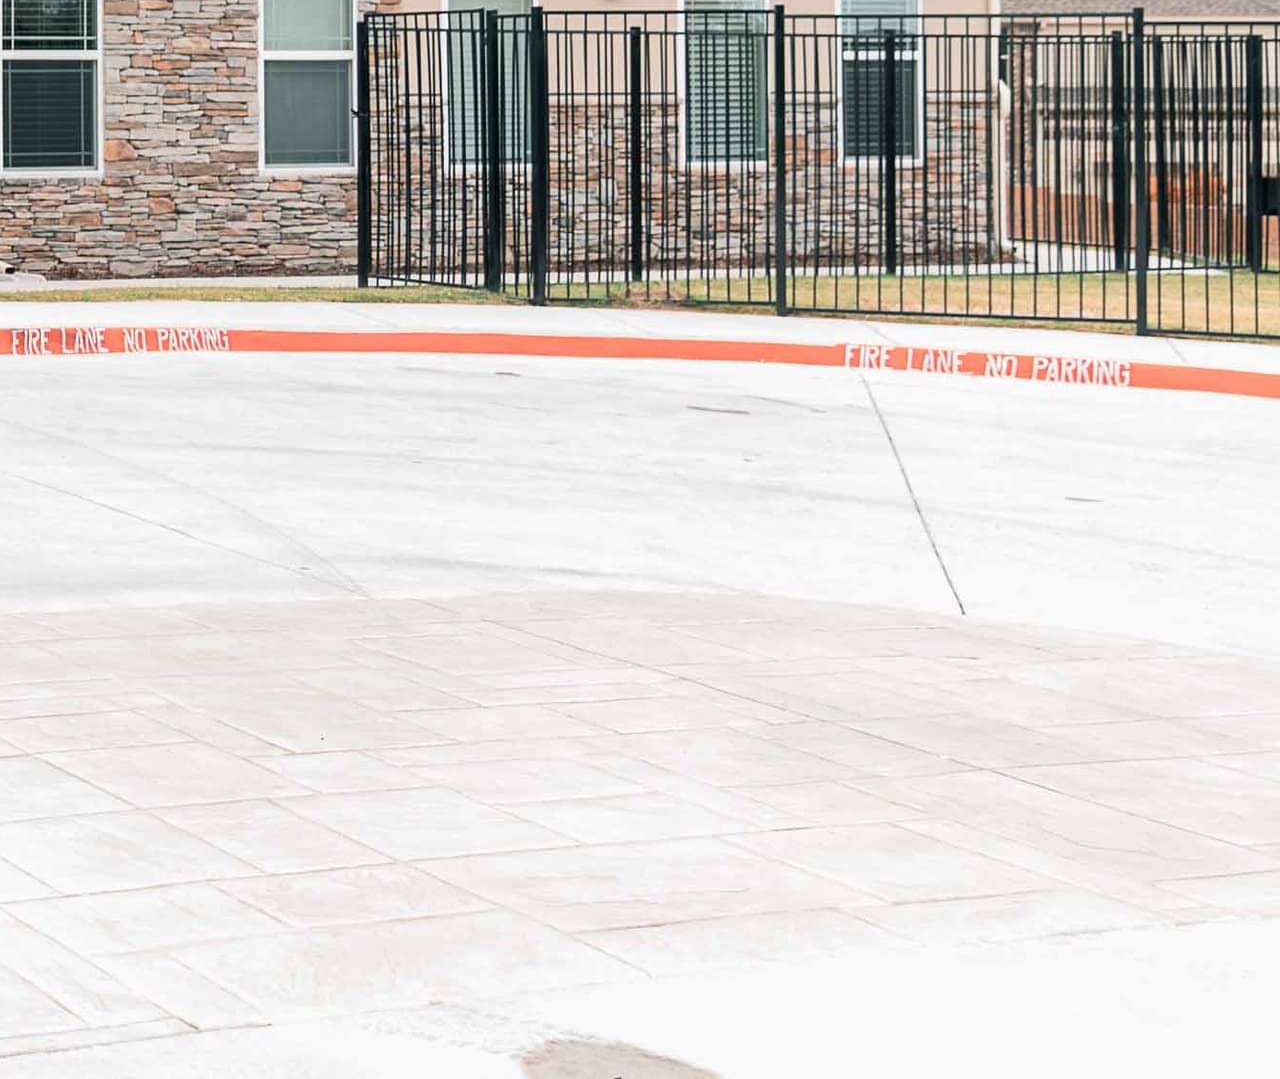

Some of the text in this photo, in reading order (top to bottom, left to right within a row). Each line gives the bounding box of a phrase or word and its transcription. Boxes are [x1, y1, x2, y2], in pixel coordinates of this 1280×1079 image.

[11, 327, 230, 356] FIRE LANE NO PARKING
[843, 344, 1131, 387] FIRE LANE NO PARKING
